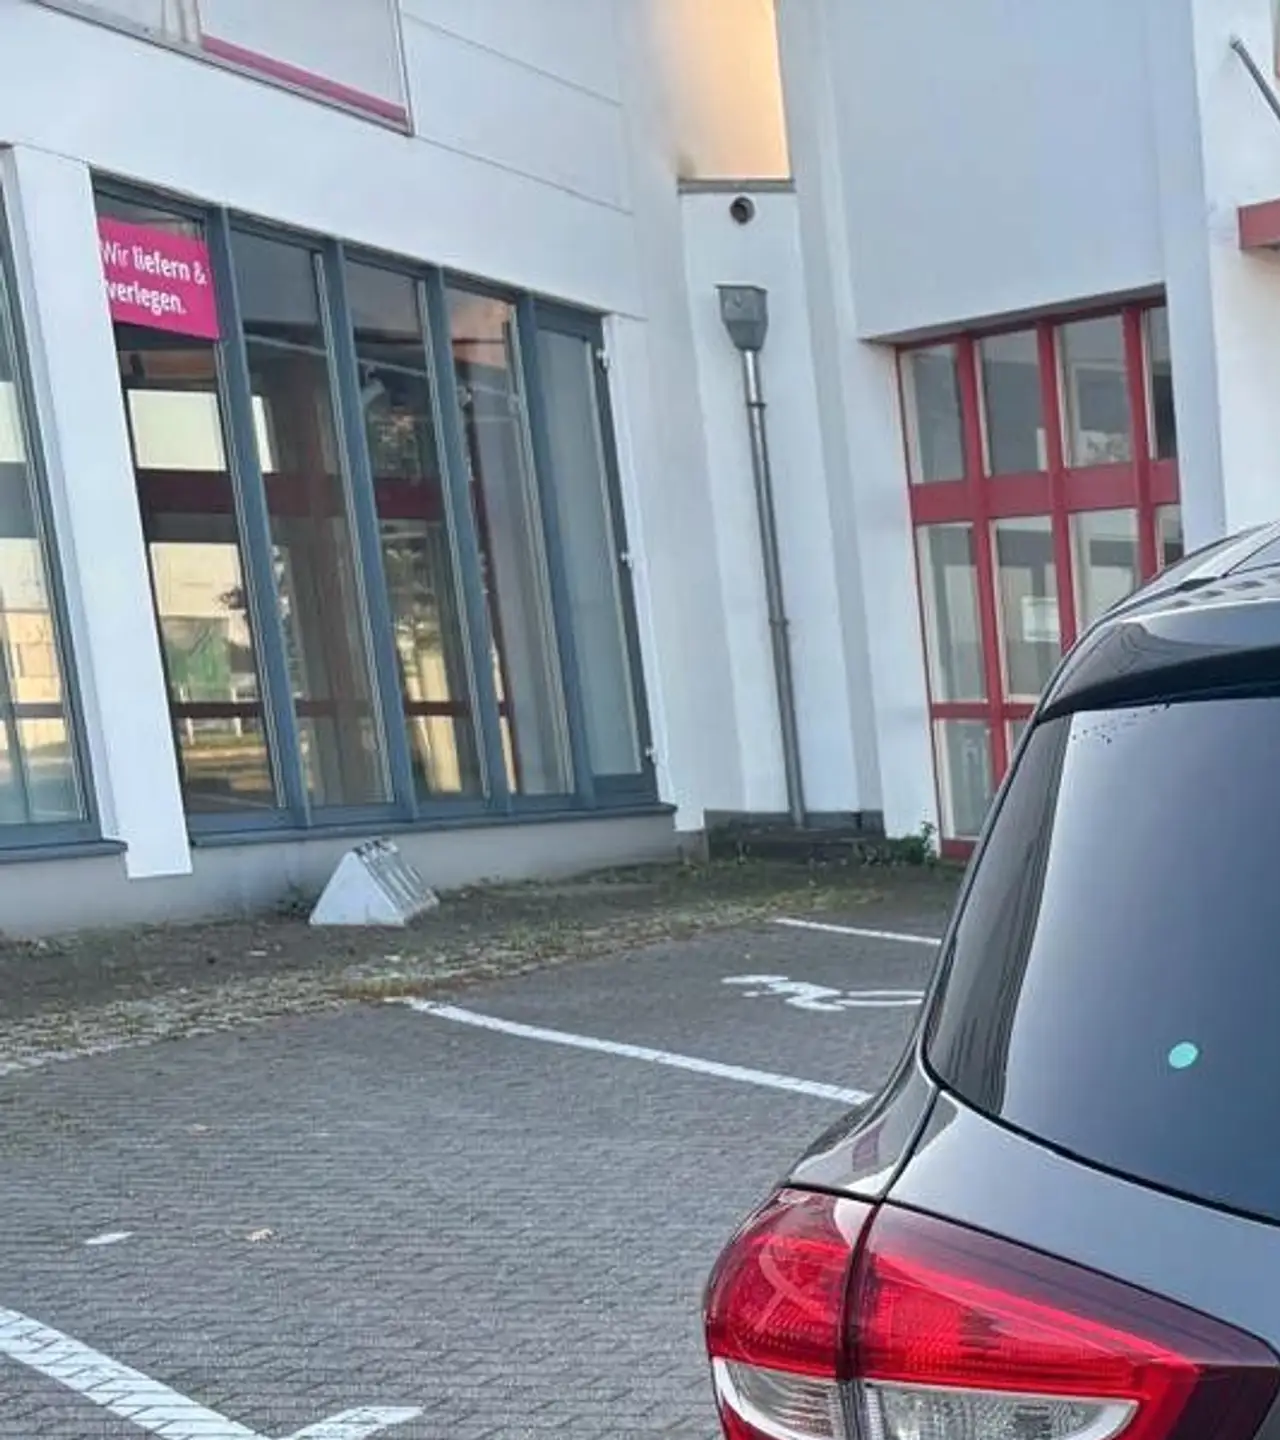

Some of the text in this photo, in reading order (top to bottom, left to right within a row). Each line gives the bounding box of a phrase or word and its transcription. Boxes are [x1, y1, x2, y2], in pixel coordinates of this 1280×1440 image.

[101, 240, 208, 285] Wir liefern &
